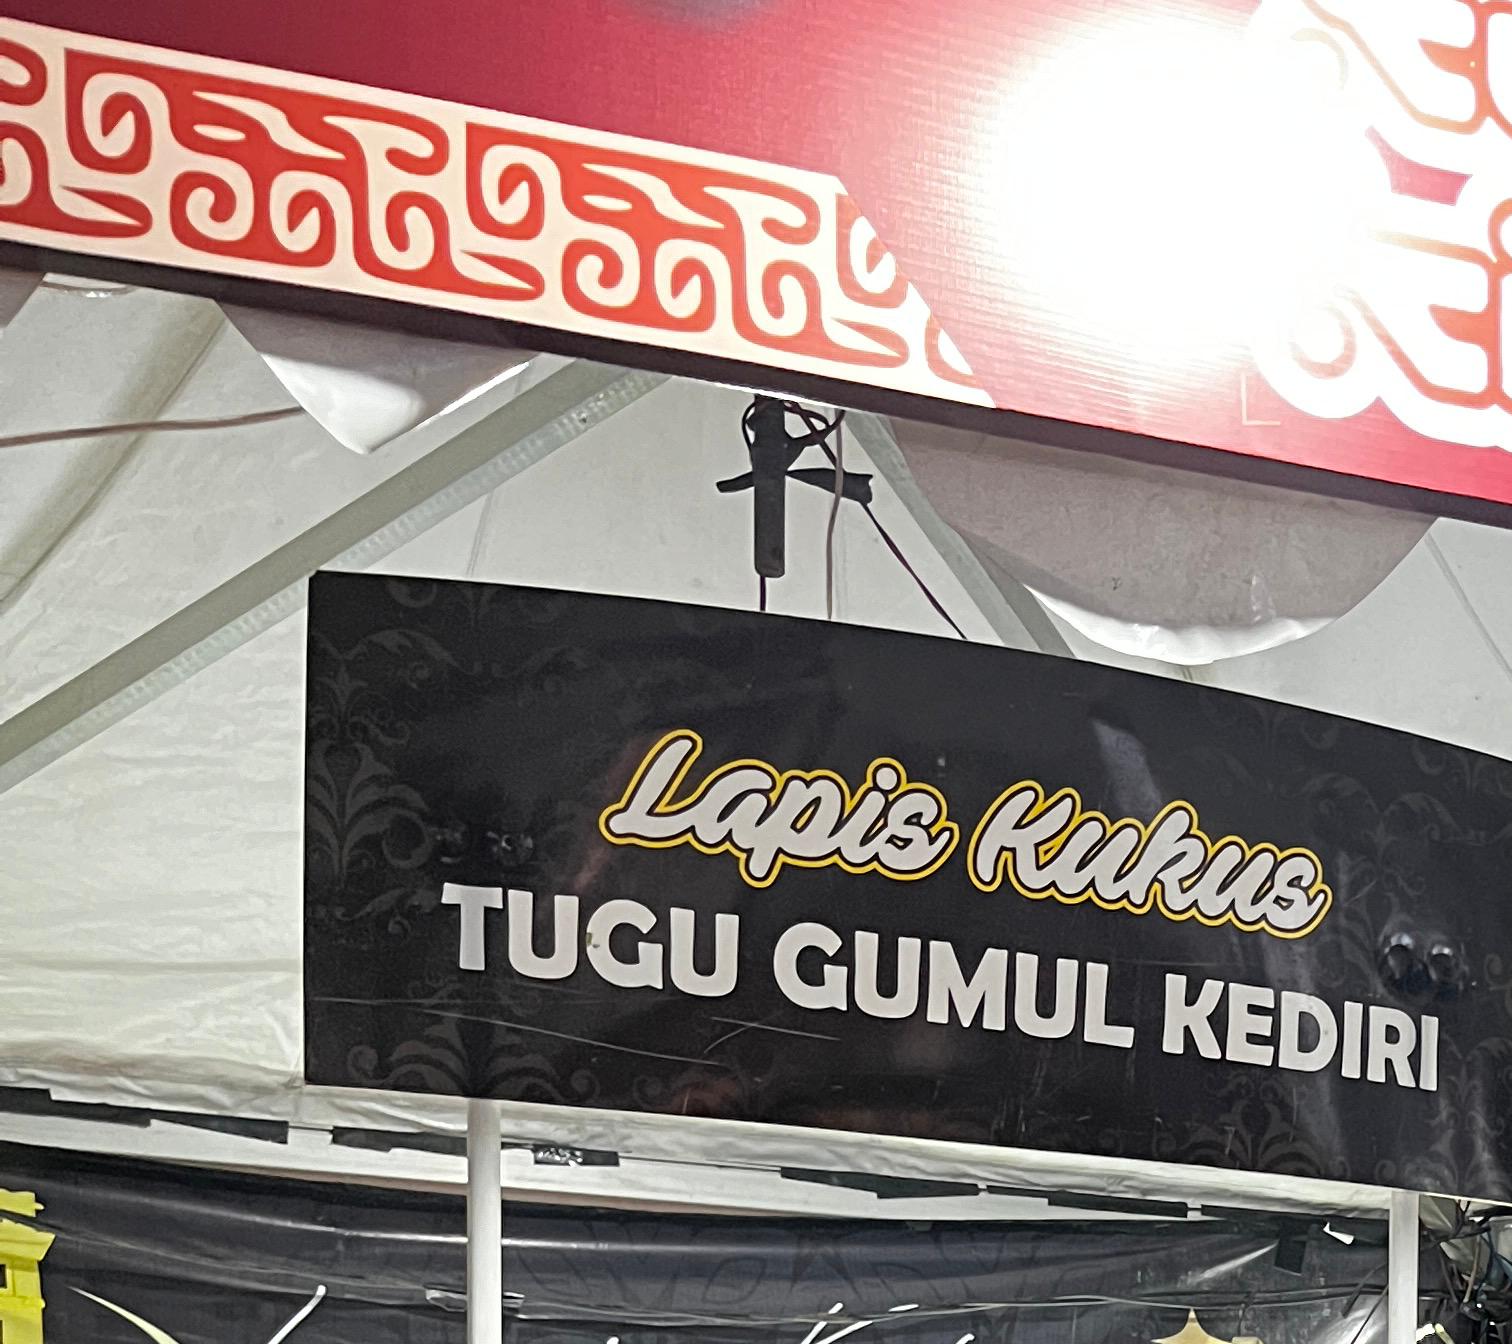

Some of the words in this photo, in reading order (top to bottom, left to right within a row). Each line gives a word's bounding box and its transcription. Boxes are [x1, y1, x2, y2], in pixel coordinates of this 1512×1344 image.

[600, 729, 956, 888] Lapis
[968, 781, 1333, 939] Kukus
[440, 882, 740, 999] TUGU
[774, 924, 1134, 1053] GUMUL
[1162, 973, 1440, 1093] KEDIRI
